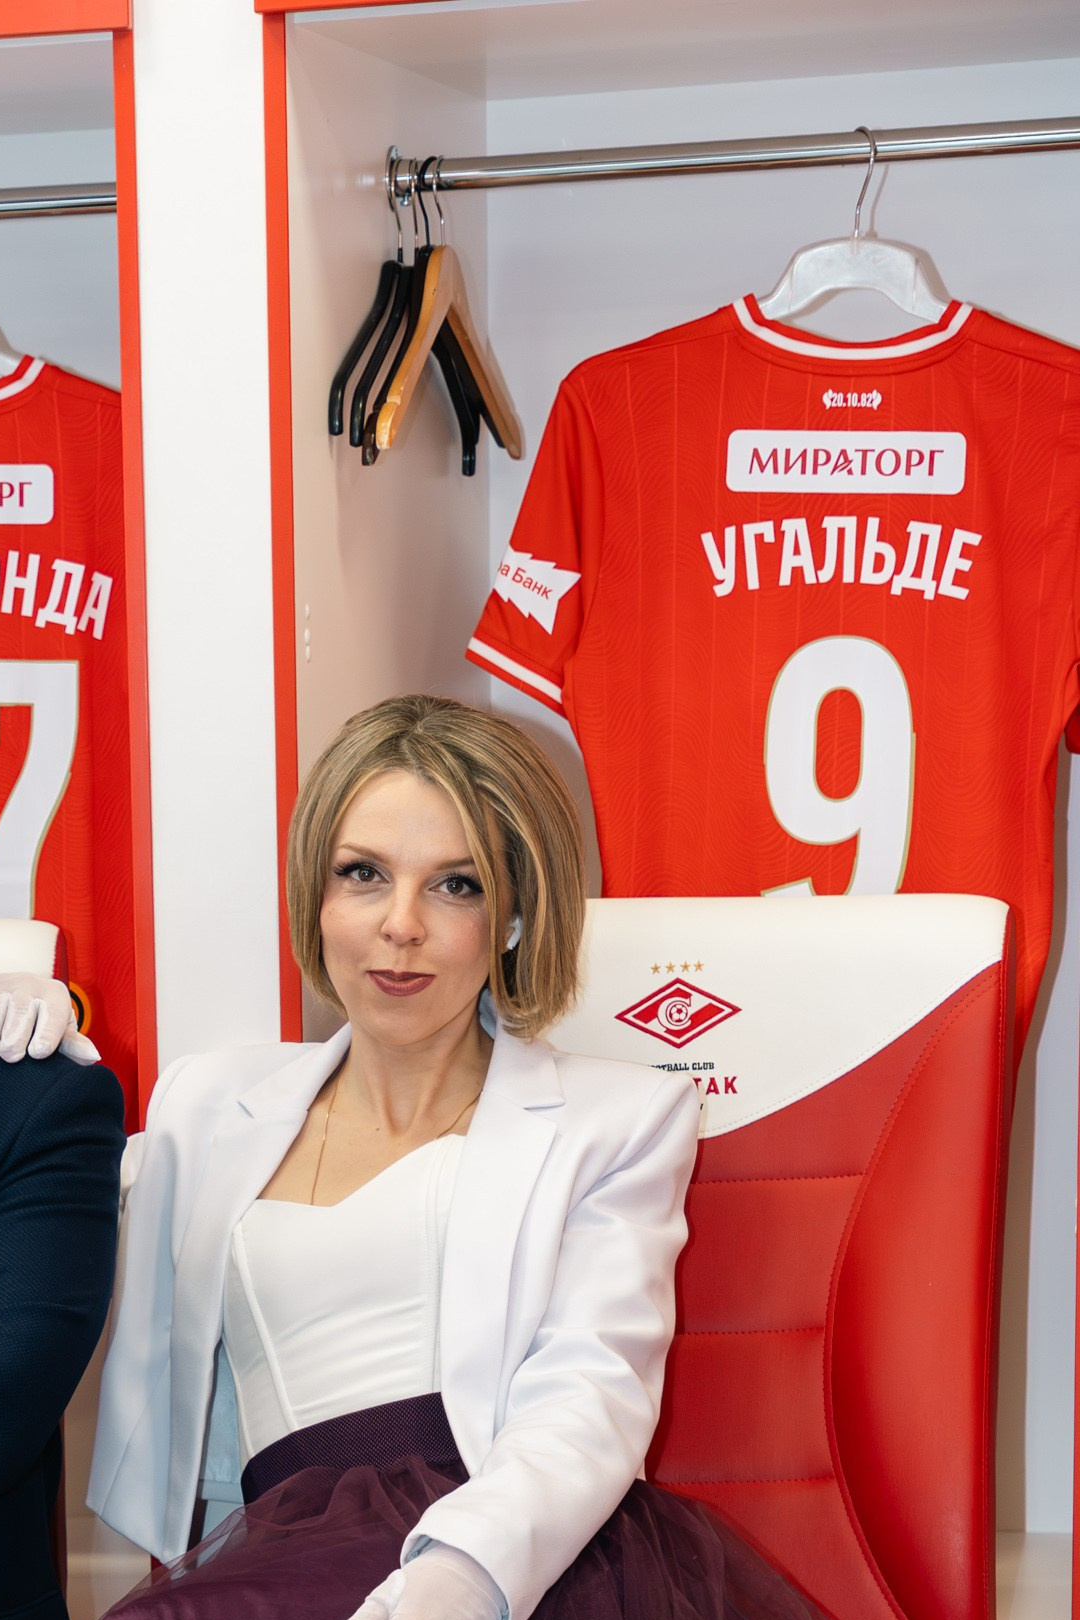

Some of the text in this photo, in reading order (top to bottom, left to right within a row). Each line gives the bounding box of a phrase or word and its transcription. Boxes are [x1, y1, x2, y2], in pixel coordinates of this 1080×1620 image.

[830, 391, 874, 408] 20.10.82
[748, 447, 944, 477] МИРАТОРГ
[700, 515, 983, 601] УГАЛЬДЕ
[511, 566, 553, 601] Банк
[761, 635, 916, 897] 9
[691, 1061, 715, 1071] CLUB
